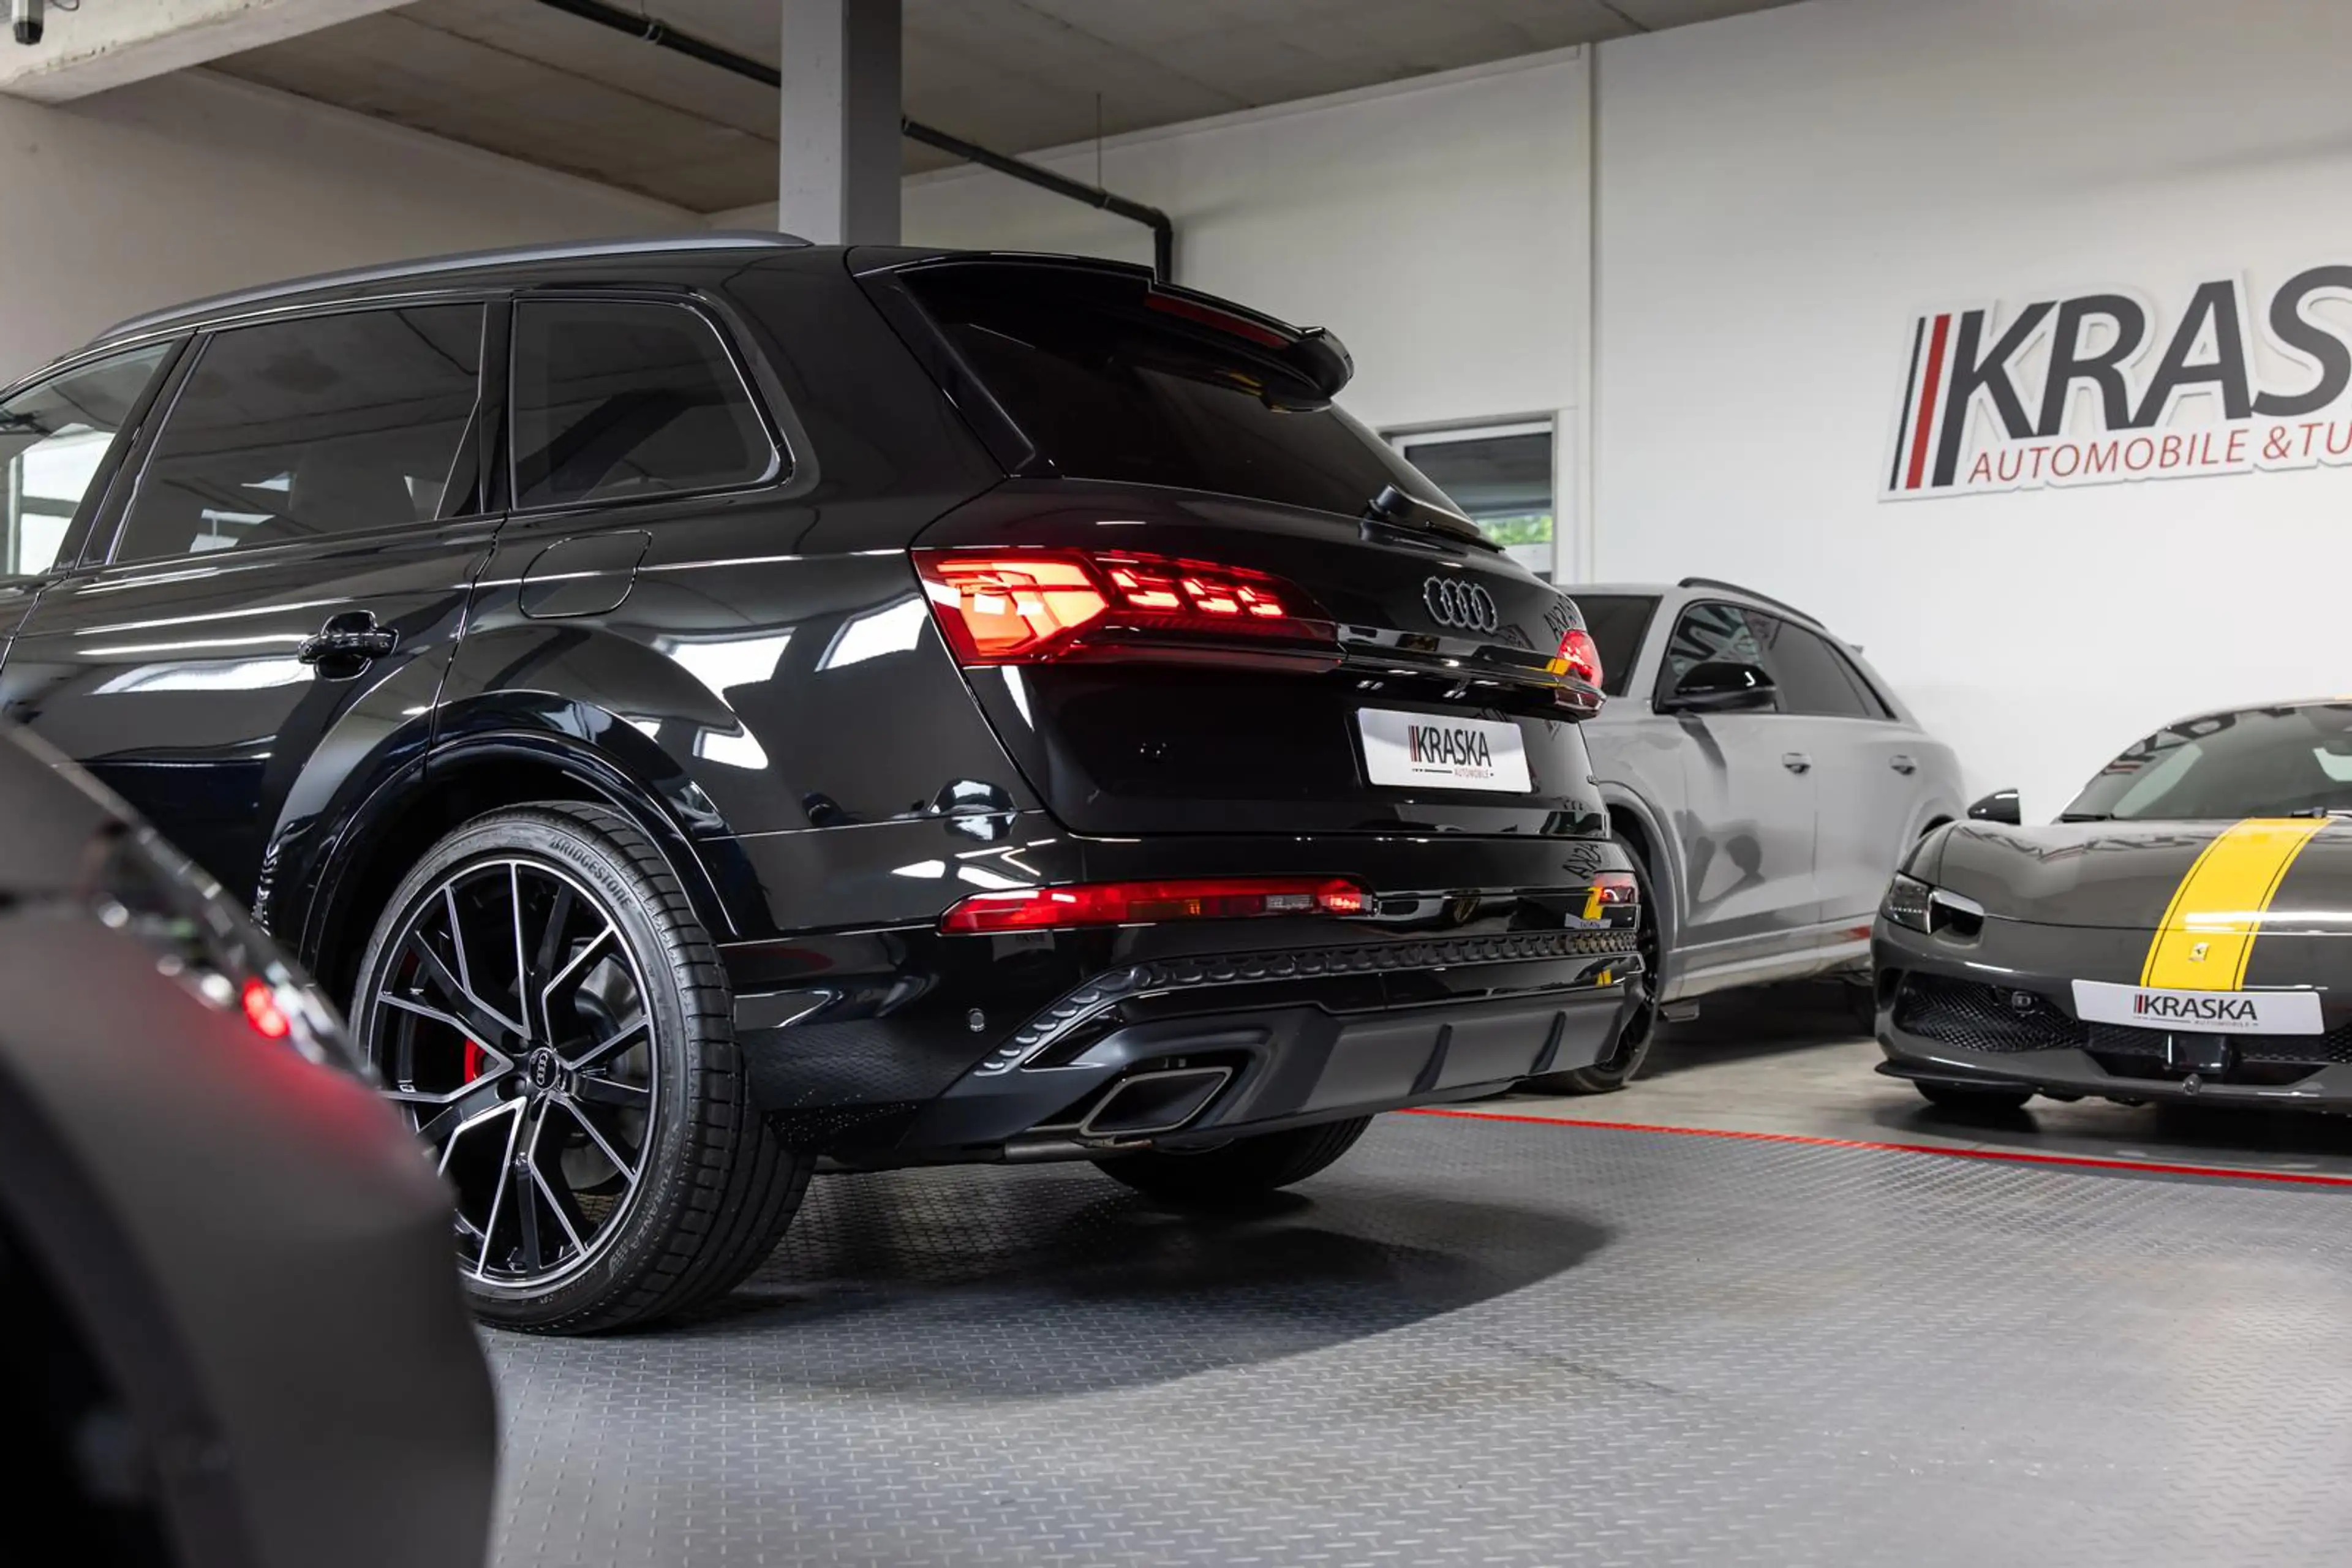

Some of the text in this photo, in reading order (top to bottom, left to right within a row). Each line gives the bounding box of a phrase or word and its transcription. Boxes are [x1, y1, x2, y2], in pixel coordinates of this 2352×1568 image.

[1969, 429, 2249, 484] AUTOMOBILE
[1415, 725, 1492, 767] KRASKA
[549, 835, 631, 910] BRIDGESTONE
[2144, 995, 2258, 1020] KRASKA
